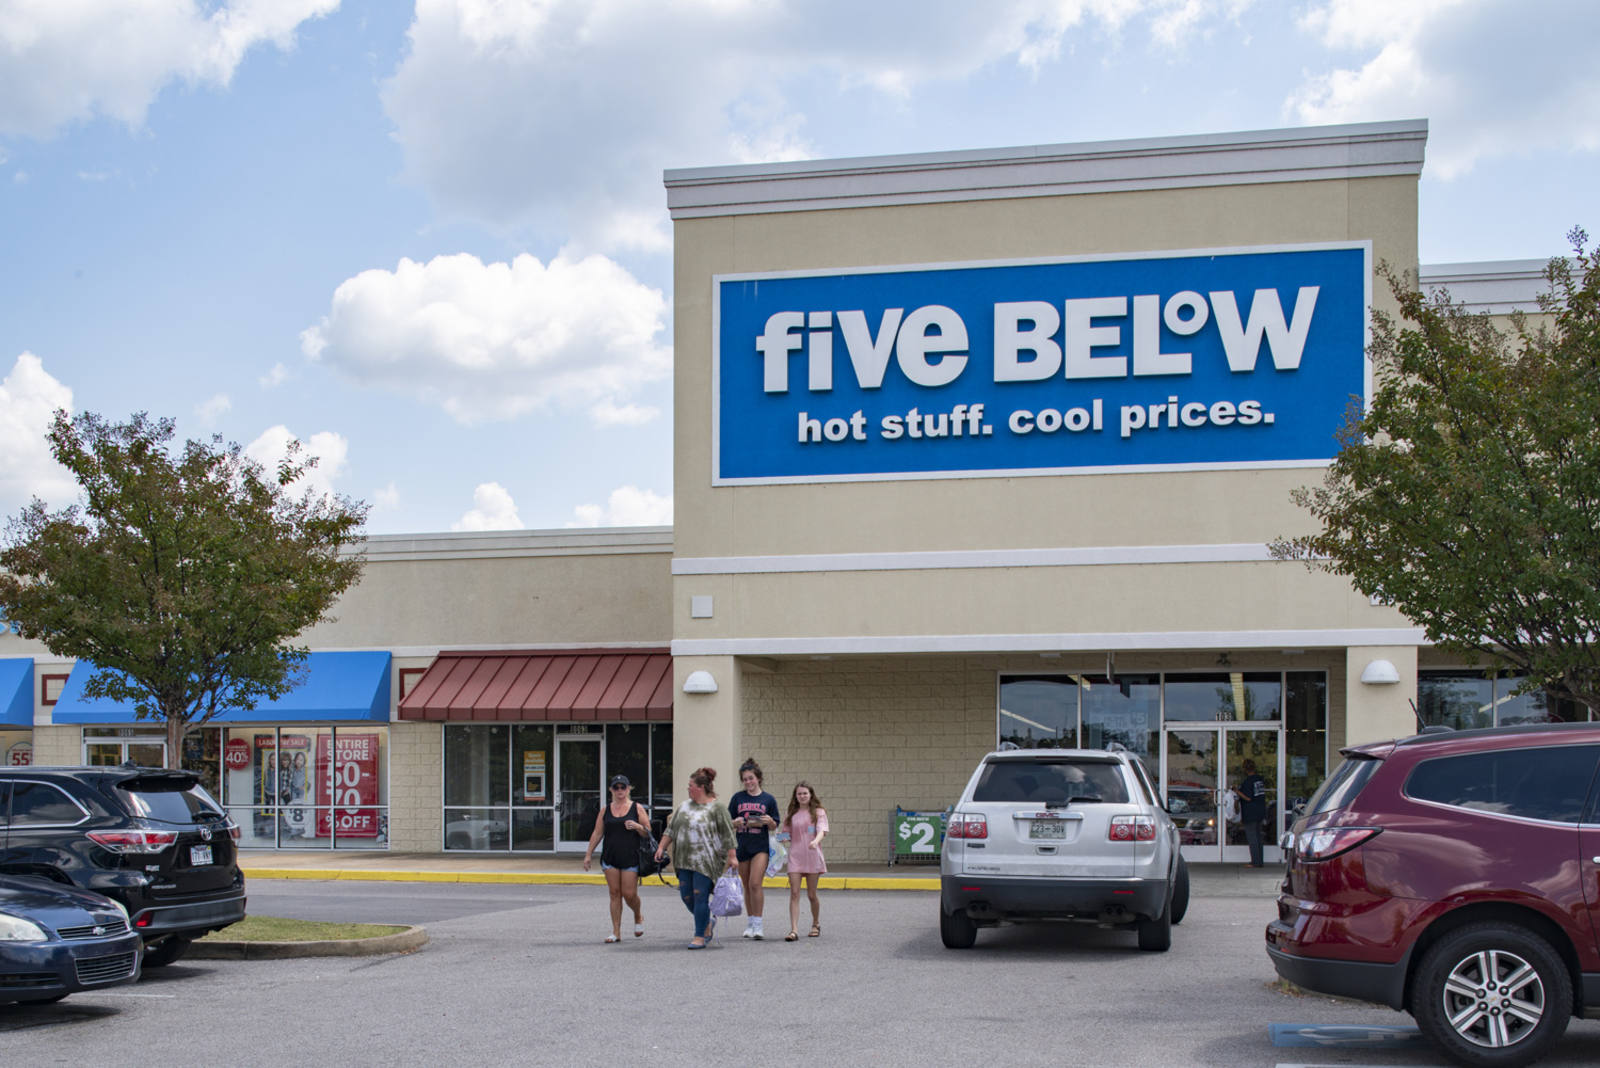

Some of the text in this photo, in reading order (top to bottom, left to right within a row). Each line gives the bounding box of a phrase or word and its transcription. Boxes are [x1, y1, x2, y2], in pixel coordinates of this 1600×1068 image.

[756, 285, 1321, 393] five BELOW
[798, 396, 1275, 442] hot stuff. cool prices.
[327, 750, 369, 761] STORE
[899, 821, 935, 853] $2
